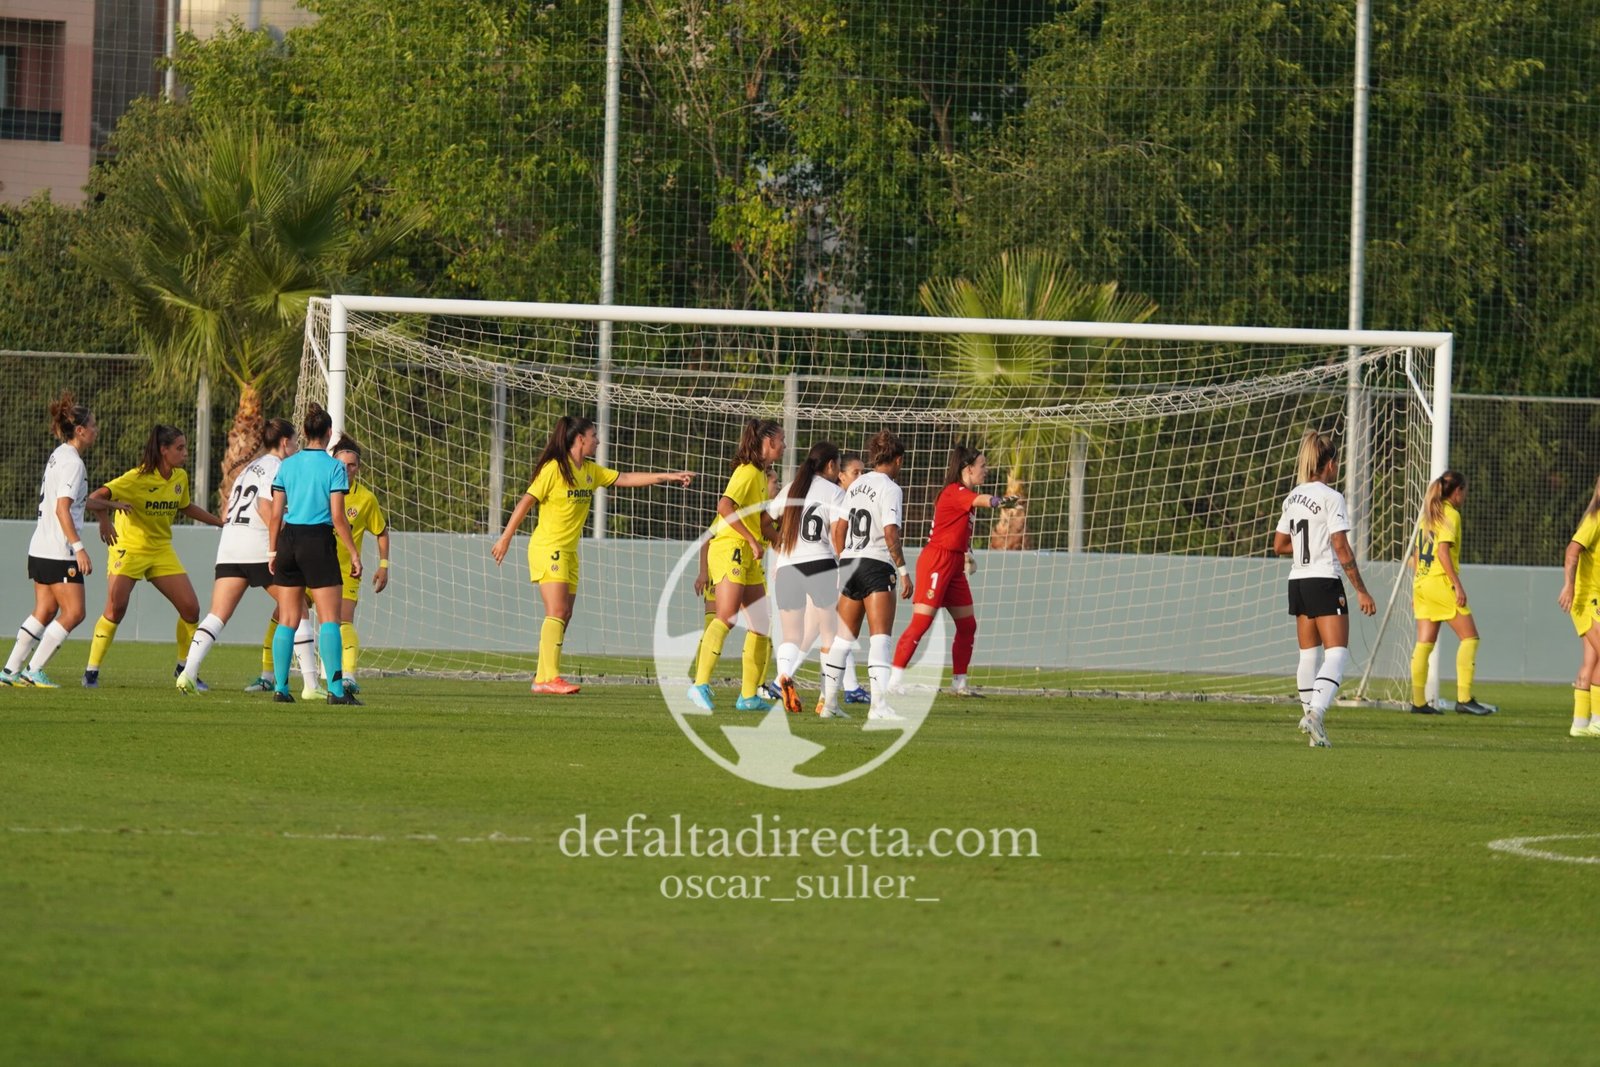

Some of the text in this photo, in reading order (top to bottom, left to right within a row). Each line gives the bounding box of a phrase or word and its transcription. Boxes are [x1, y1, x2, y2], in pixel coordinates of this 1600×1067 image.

[226, 484, 259, 525] 22
[800, 501, 824, 544] 6
[848, 507, 872, 552] 19
[117, 549, 127, 559] 7
[732, 548, 743, 565] 4
[930, 572, 940, 590] 1
